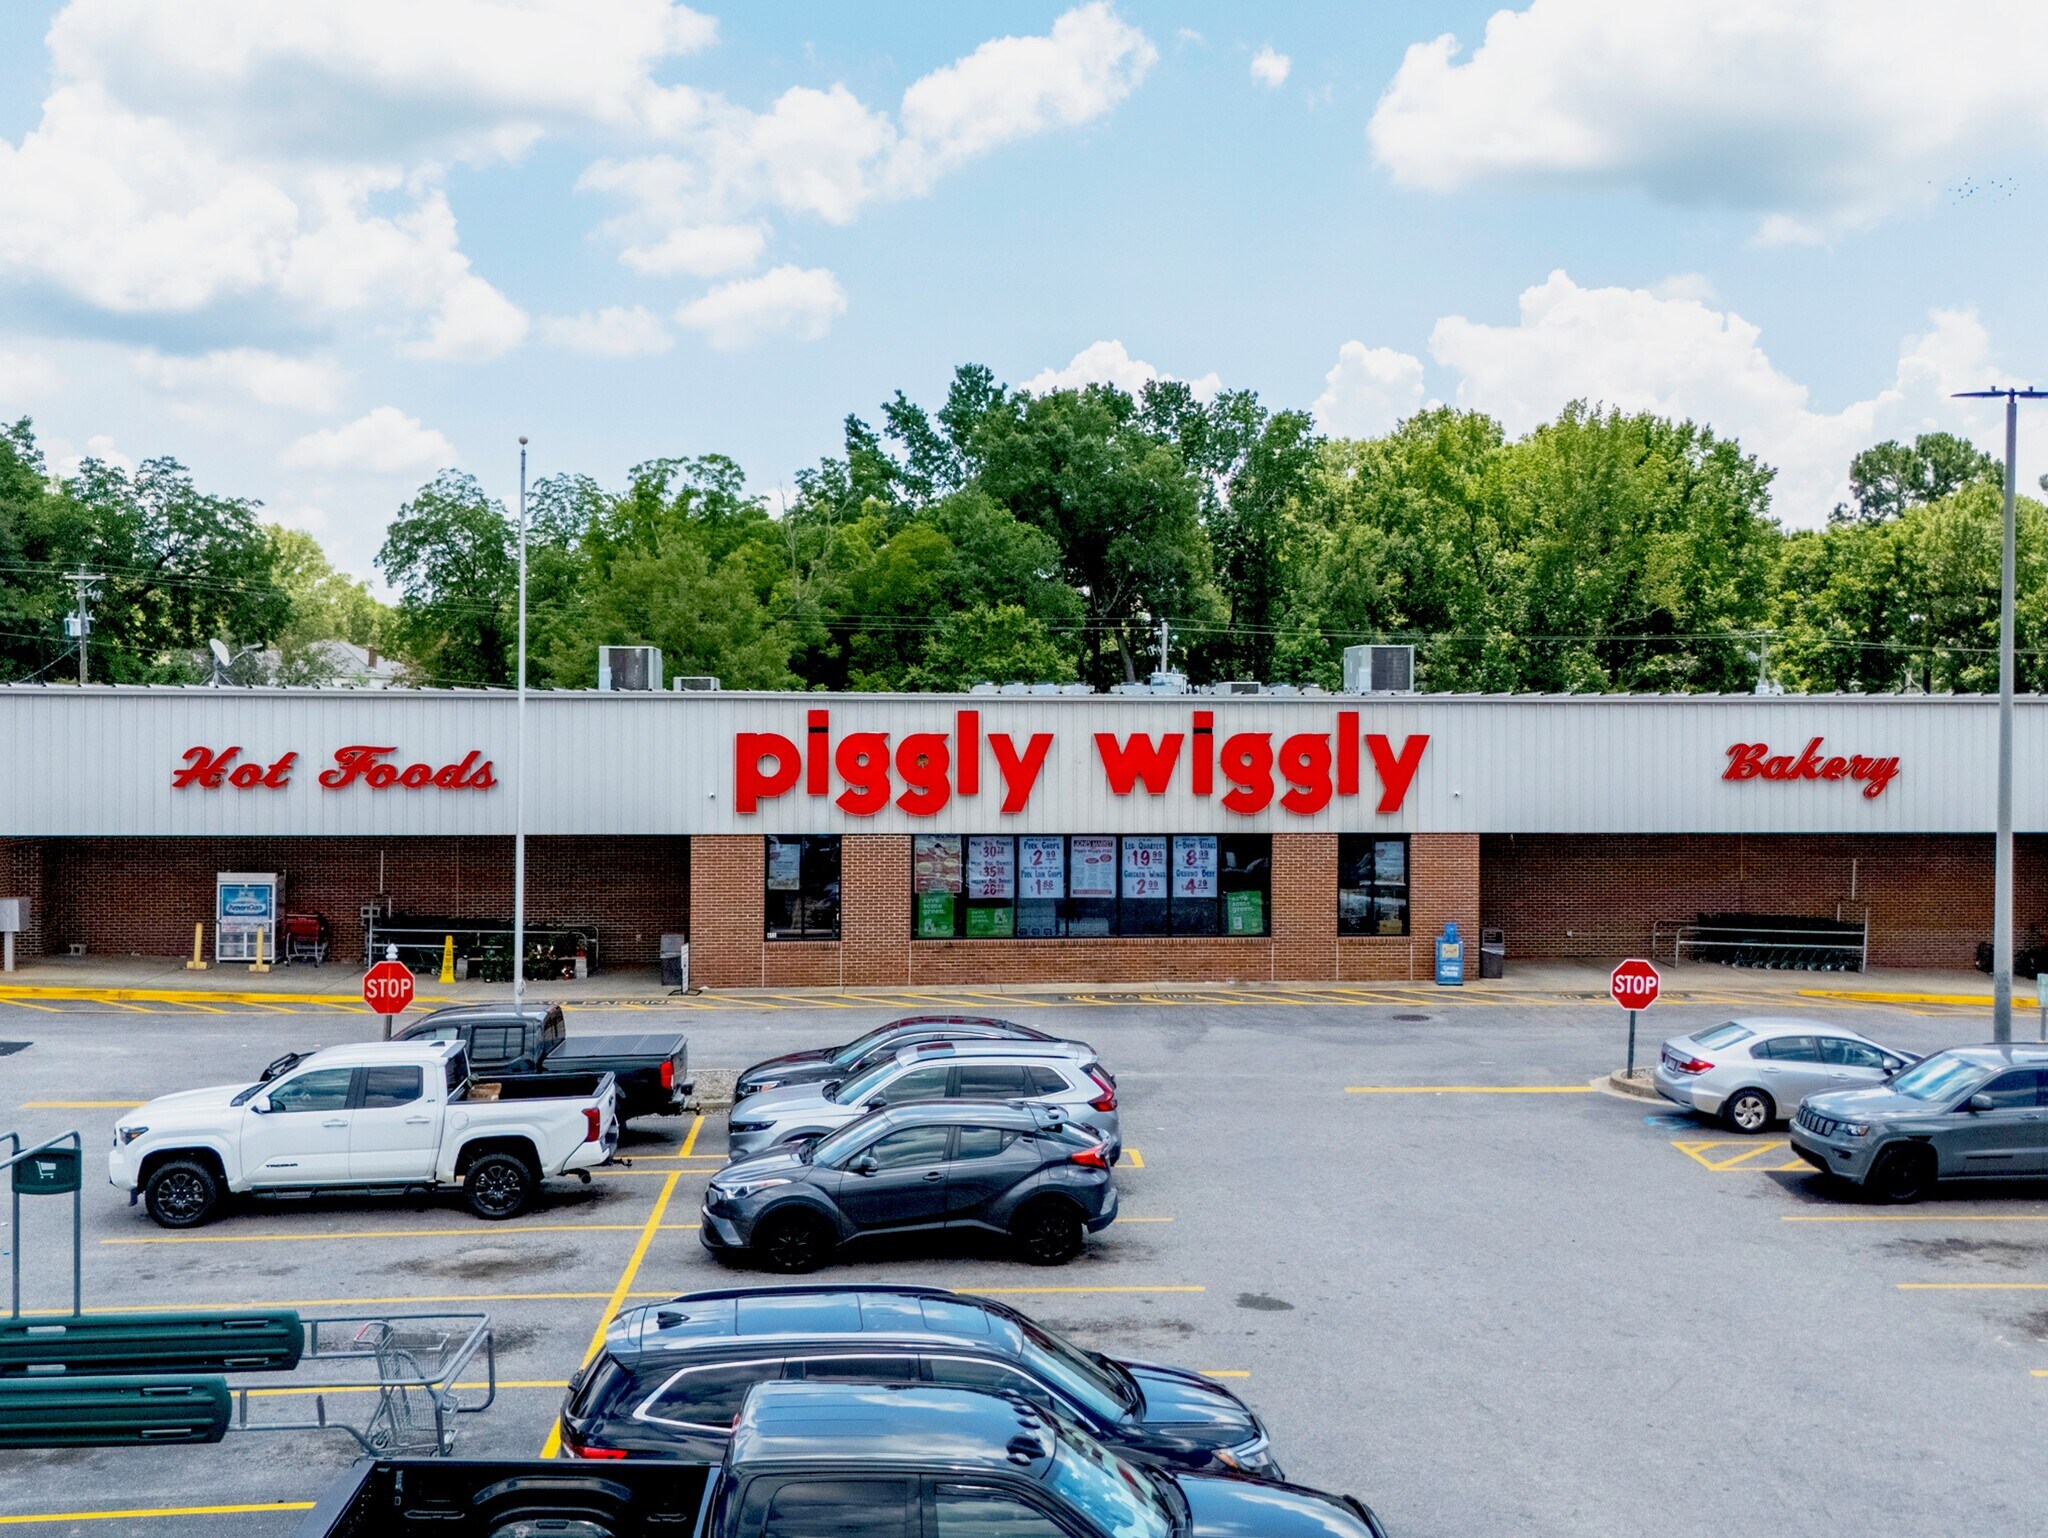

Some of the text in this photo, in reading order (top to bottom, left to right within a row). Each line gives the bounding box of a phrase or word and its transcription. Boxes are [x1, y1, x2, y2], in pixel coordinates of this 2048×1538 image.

[172, 745, 498, 789] Hot Foods
[736, 709, 1430, 816] piggly wiggly
[1722, 737, 1900, 799] Bakery
[366, 978, 412, 998] STOP
[1614, 974, 1657, 995] STOP
